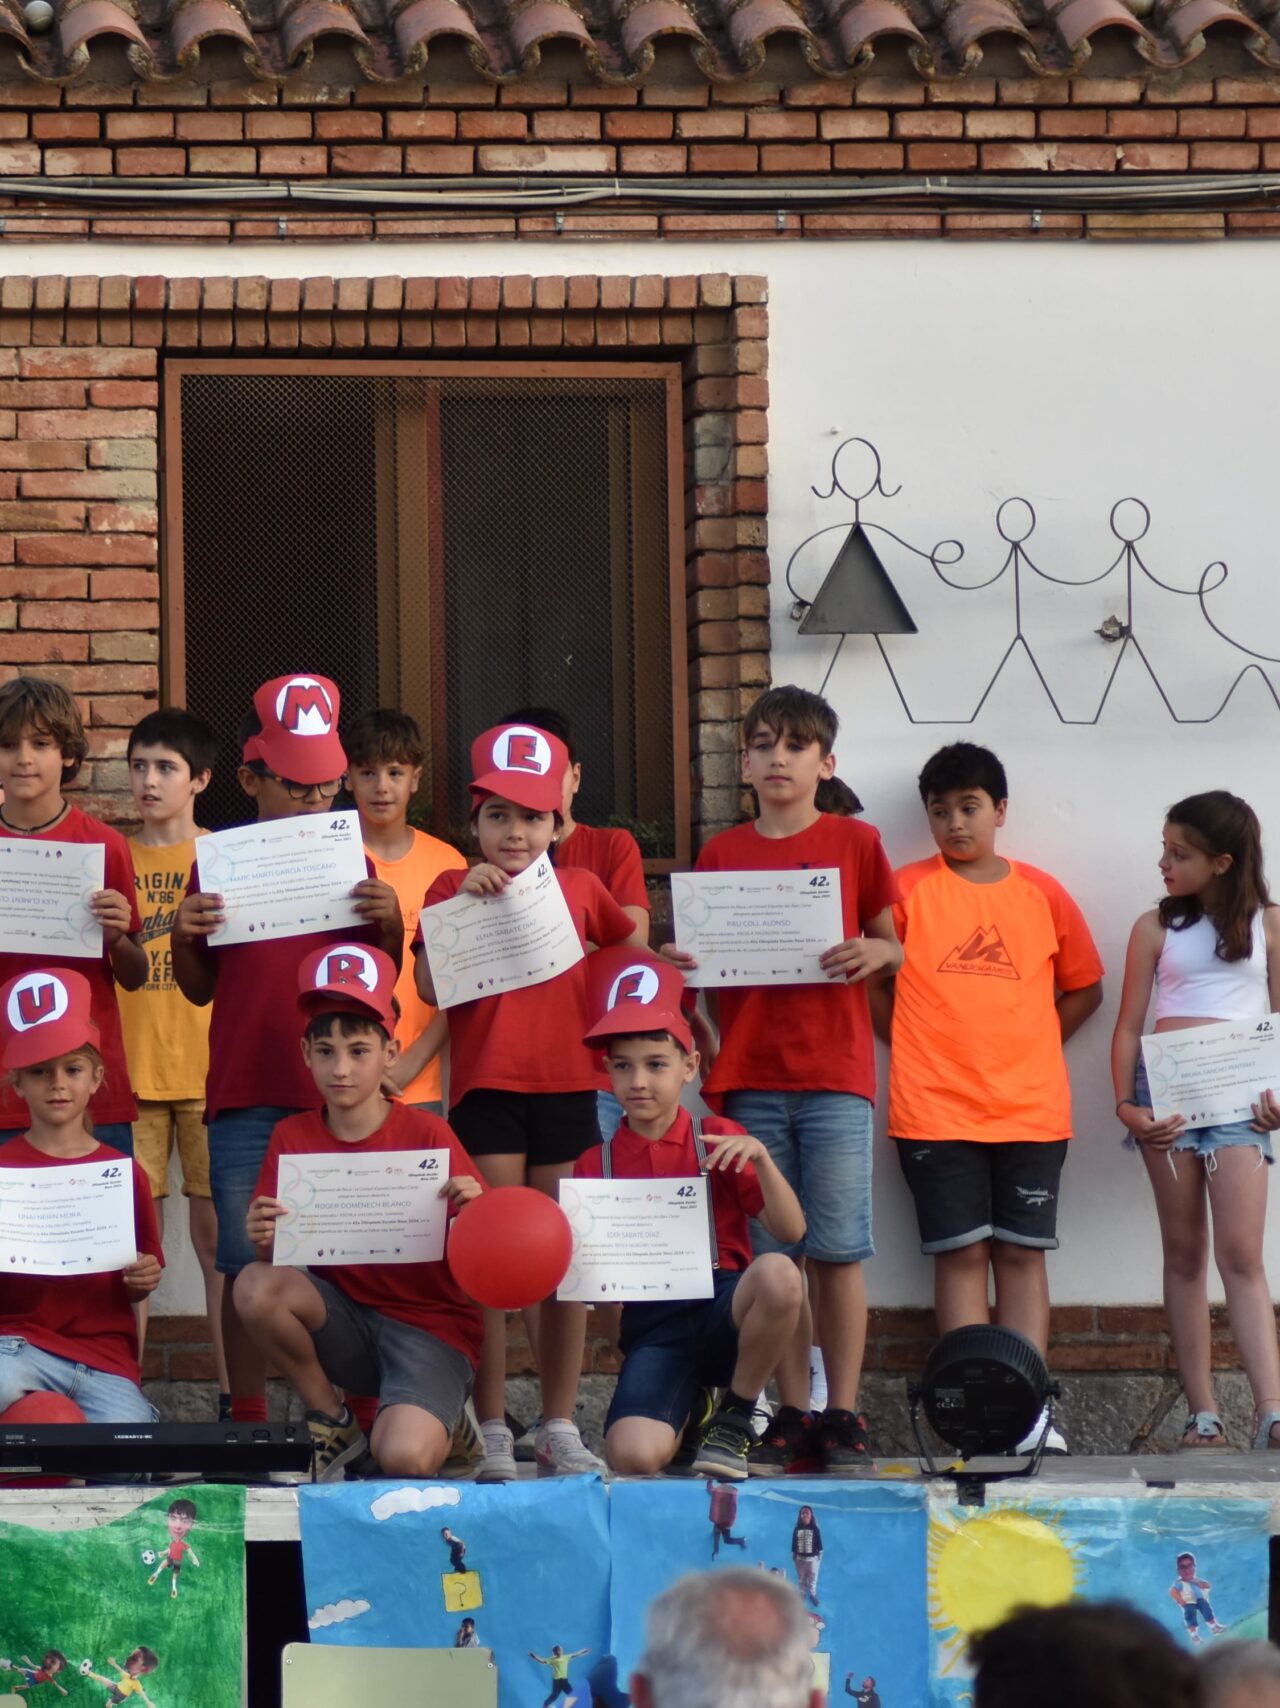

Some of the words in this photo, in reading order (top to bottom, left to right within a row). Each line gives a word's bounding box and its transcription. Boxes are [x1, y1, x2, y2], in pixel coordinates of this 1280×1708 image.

[282, 684, 332, 736] M
[507, 735, 541, 772] E
[763, 919, 791, 927] ALONSO
[325, 953, 370, 991] R
[17, 984, 57, 1025] U
[314, 1202, 339, 1210] ROGER
[382, 1200, 412, 1208] BLANCO
